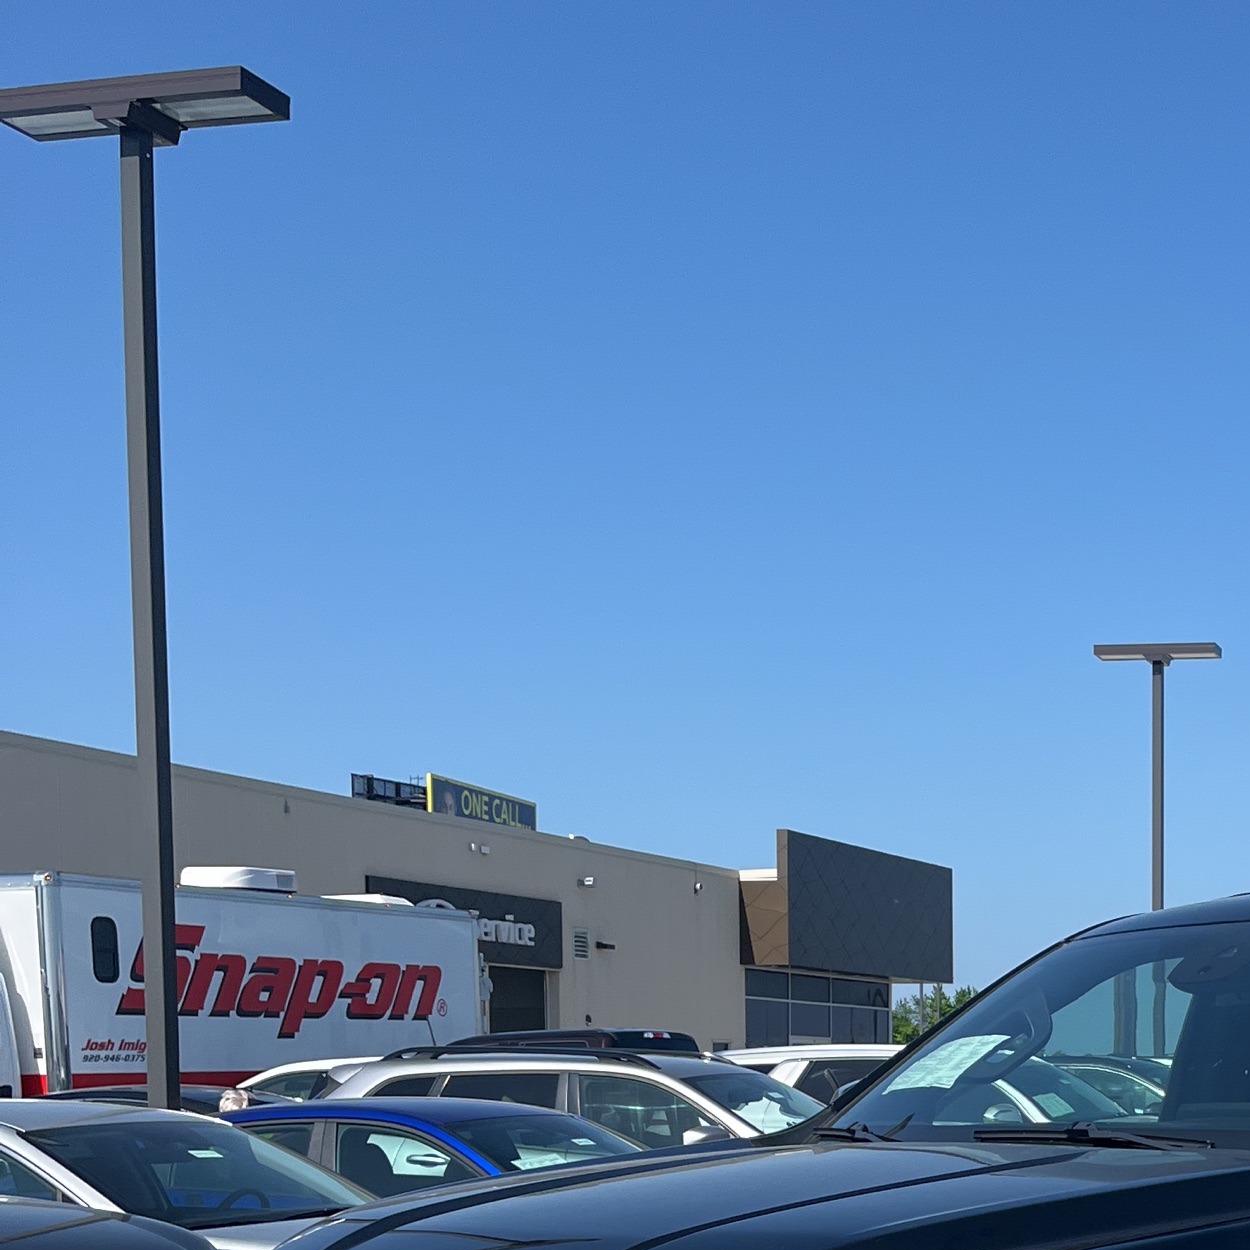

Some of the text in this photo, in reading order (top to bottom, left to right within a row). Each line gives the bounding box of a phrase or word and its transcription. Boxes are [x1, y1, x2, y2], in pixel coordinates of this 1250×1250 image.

[461, 790, 489, 820] ONE
[478, 914, 536, 946] ervice
[115, 924, 442, 1039] Snap-on
[81, 1038, 115, 1051] Josh
